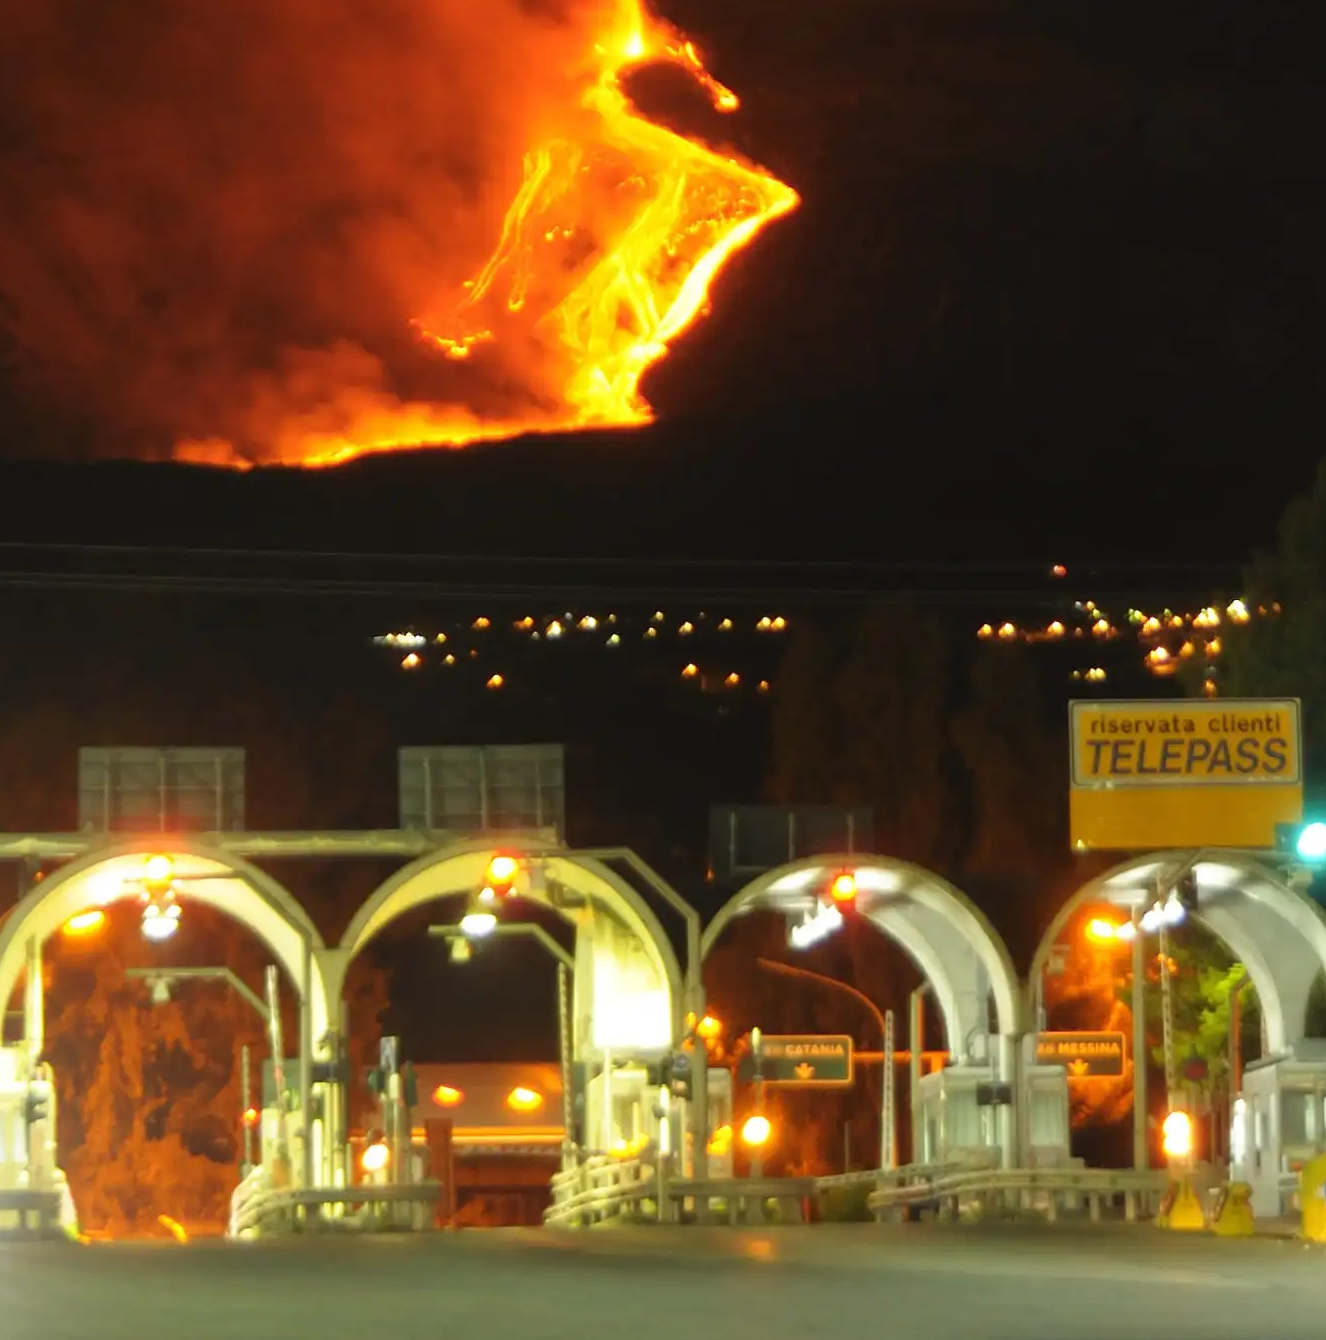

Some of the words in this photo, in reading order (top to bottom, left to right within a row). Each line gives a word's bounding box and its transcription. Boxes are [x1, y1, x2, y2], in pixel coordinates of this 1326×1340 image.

[1090, 714, 1195, 734] riservata
[1208, 713, 1281, 733] clienti
[1086, 737, 1288, 774] TELEPASS
[785, 1044, 844, 1057] CATANIA
[1058, 1042, 1121, 1055] MESSINA
